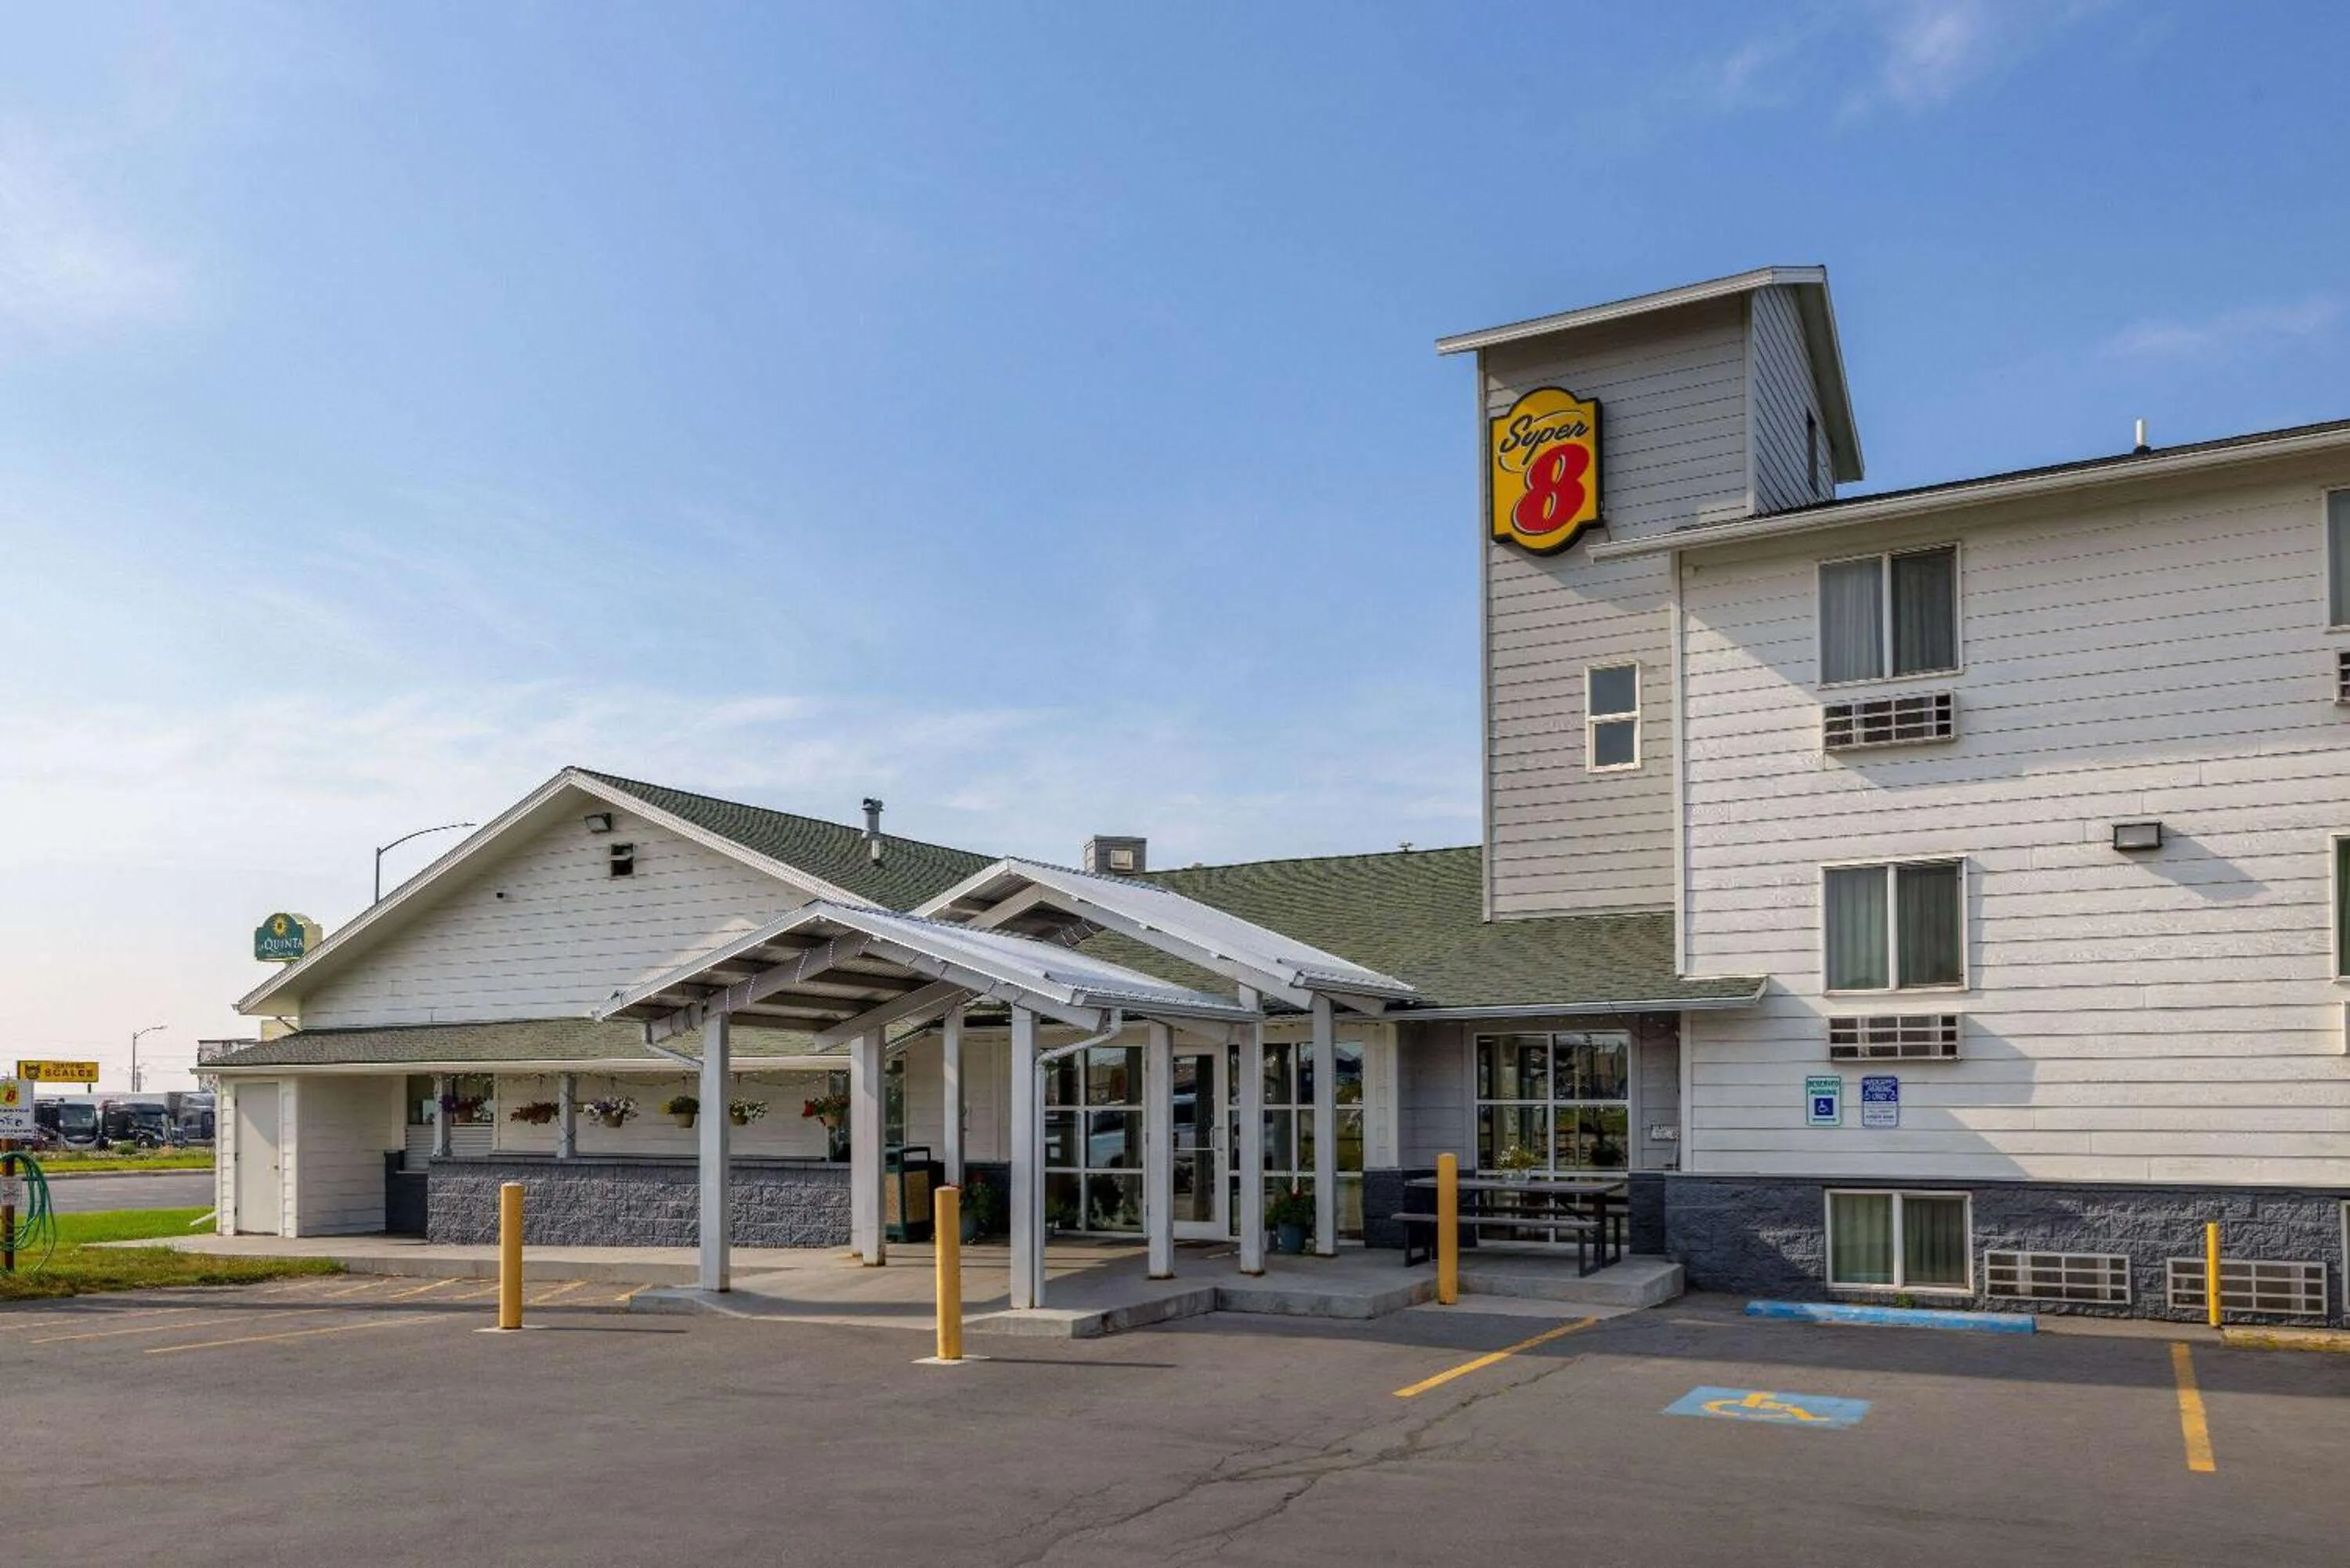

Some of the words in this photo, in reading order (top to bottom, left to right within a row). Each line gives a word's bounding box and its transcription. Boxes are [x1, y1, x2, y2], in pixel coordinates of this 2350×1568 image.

[1499, 411, 1589, 468] Super
[1510, 443, 1590, 536] 8
[264, 937, 303, 952] QUINTA
[45, 1068, 93, 1077] SCALES
